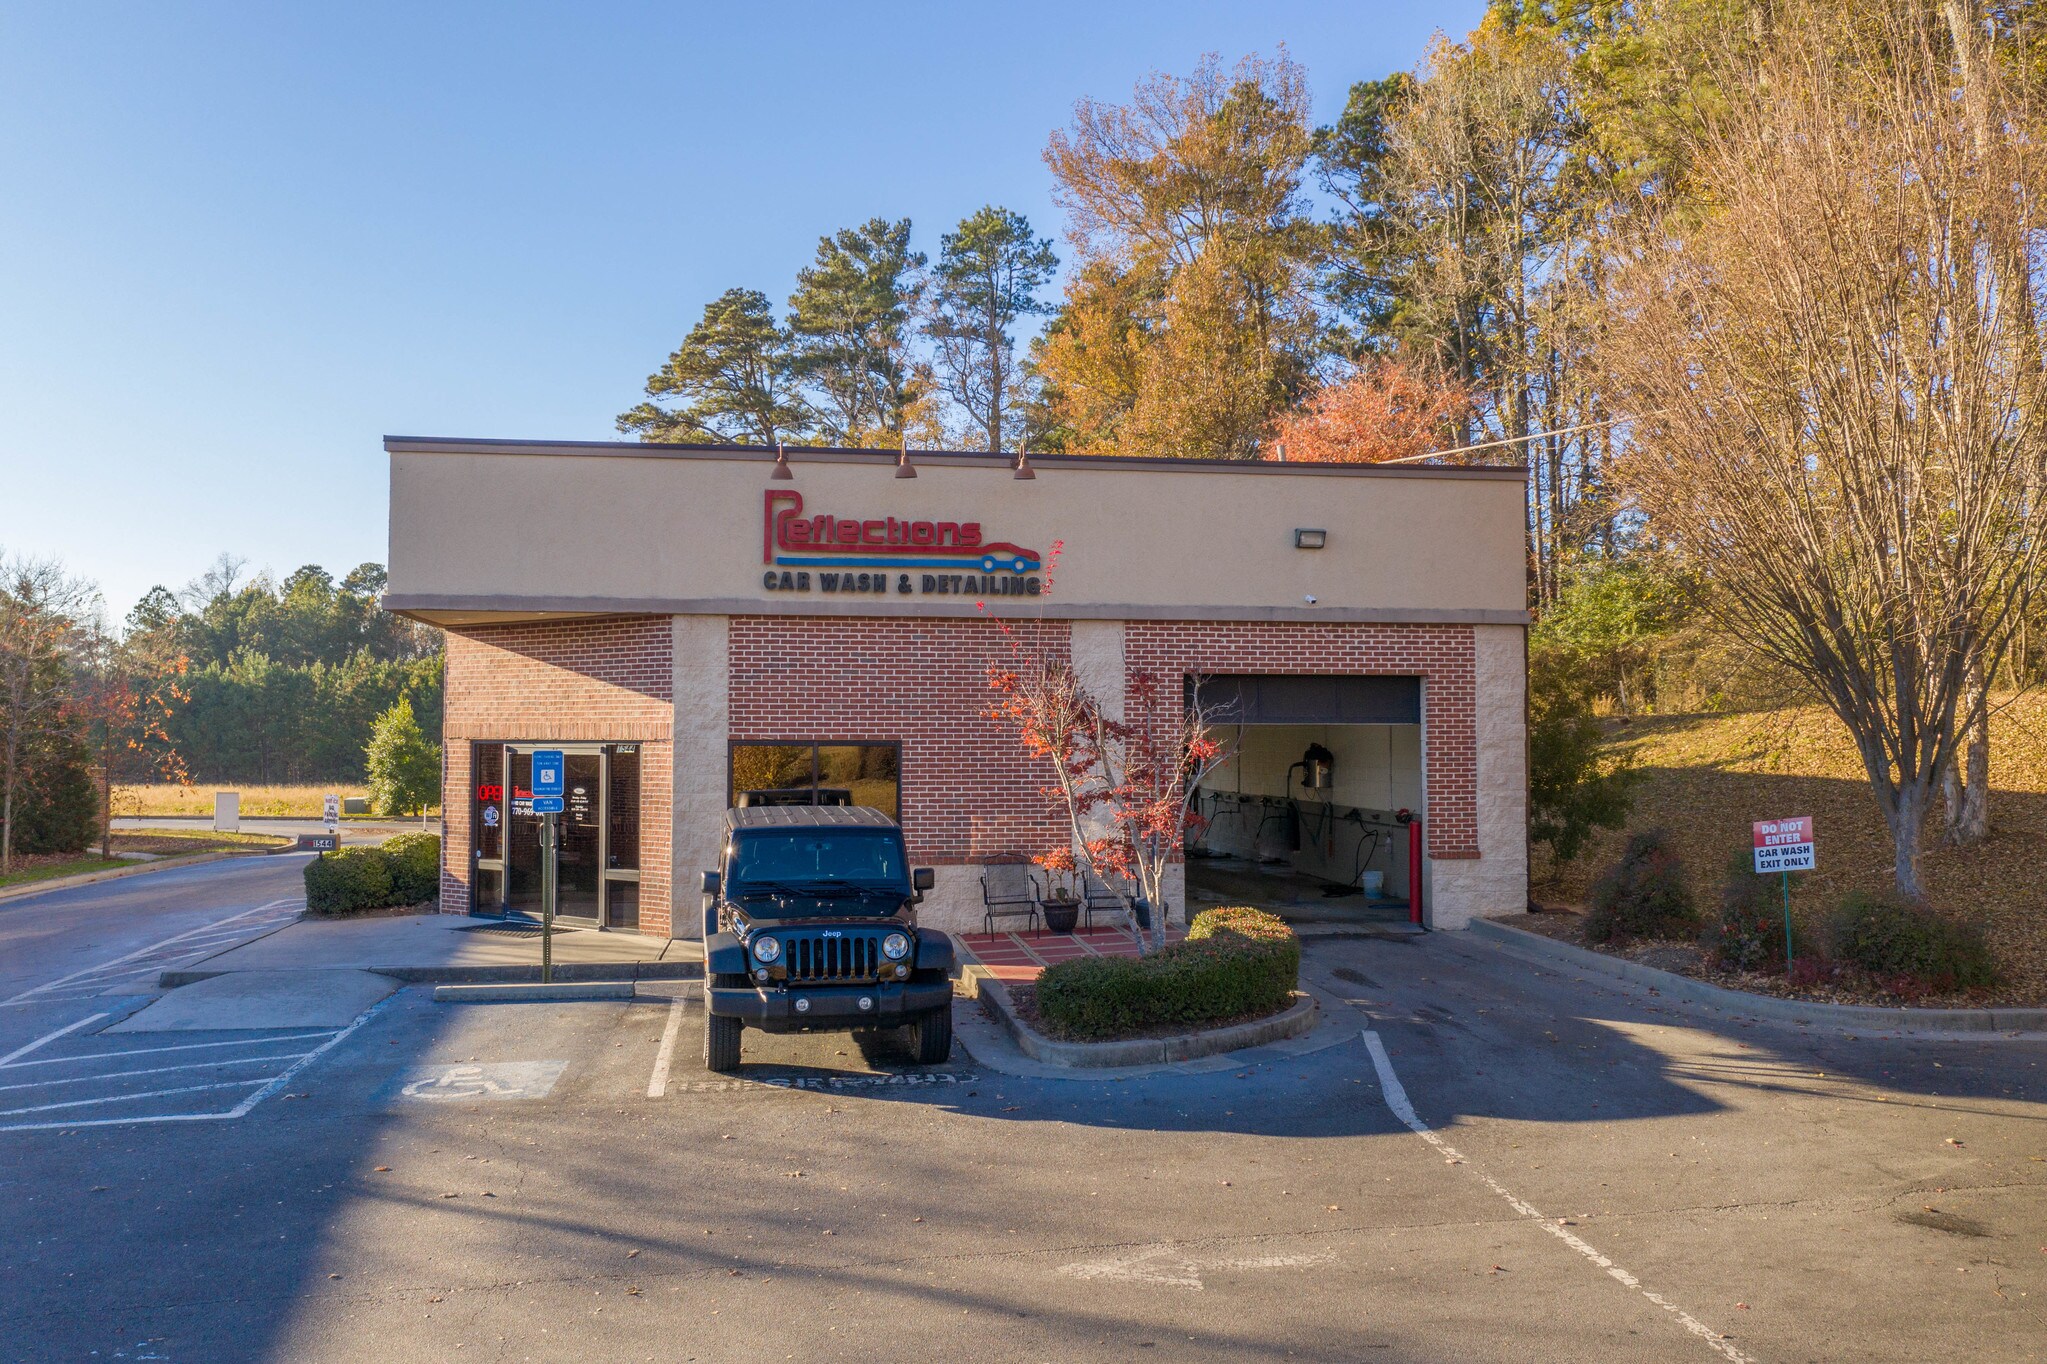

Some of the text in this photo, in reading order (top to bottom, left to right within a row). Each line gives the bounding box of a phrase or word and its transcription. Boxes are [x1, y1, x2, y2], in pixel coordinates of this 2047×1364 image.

[763, 489, 982, 564] Reflections
[763, 571, 1042, 595] CAR WASH & DETAILING
[479, 785, 503, 800] OPE
[1762, 822, 1803, 834] DO NOT
[1766, 833, 1800, 845] ENTER
[1759, 846, 1810, 857] CAR WASH
[1761, 857, 1810, 868] EXIT ONLY
[822, 930, 842, 938] Jeep
